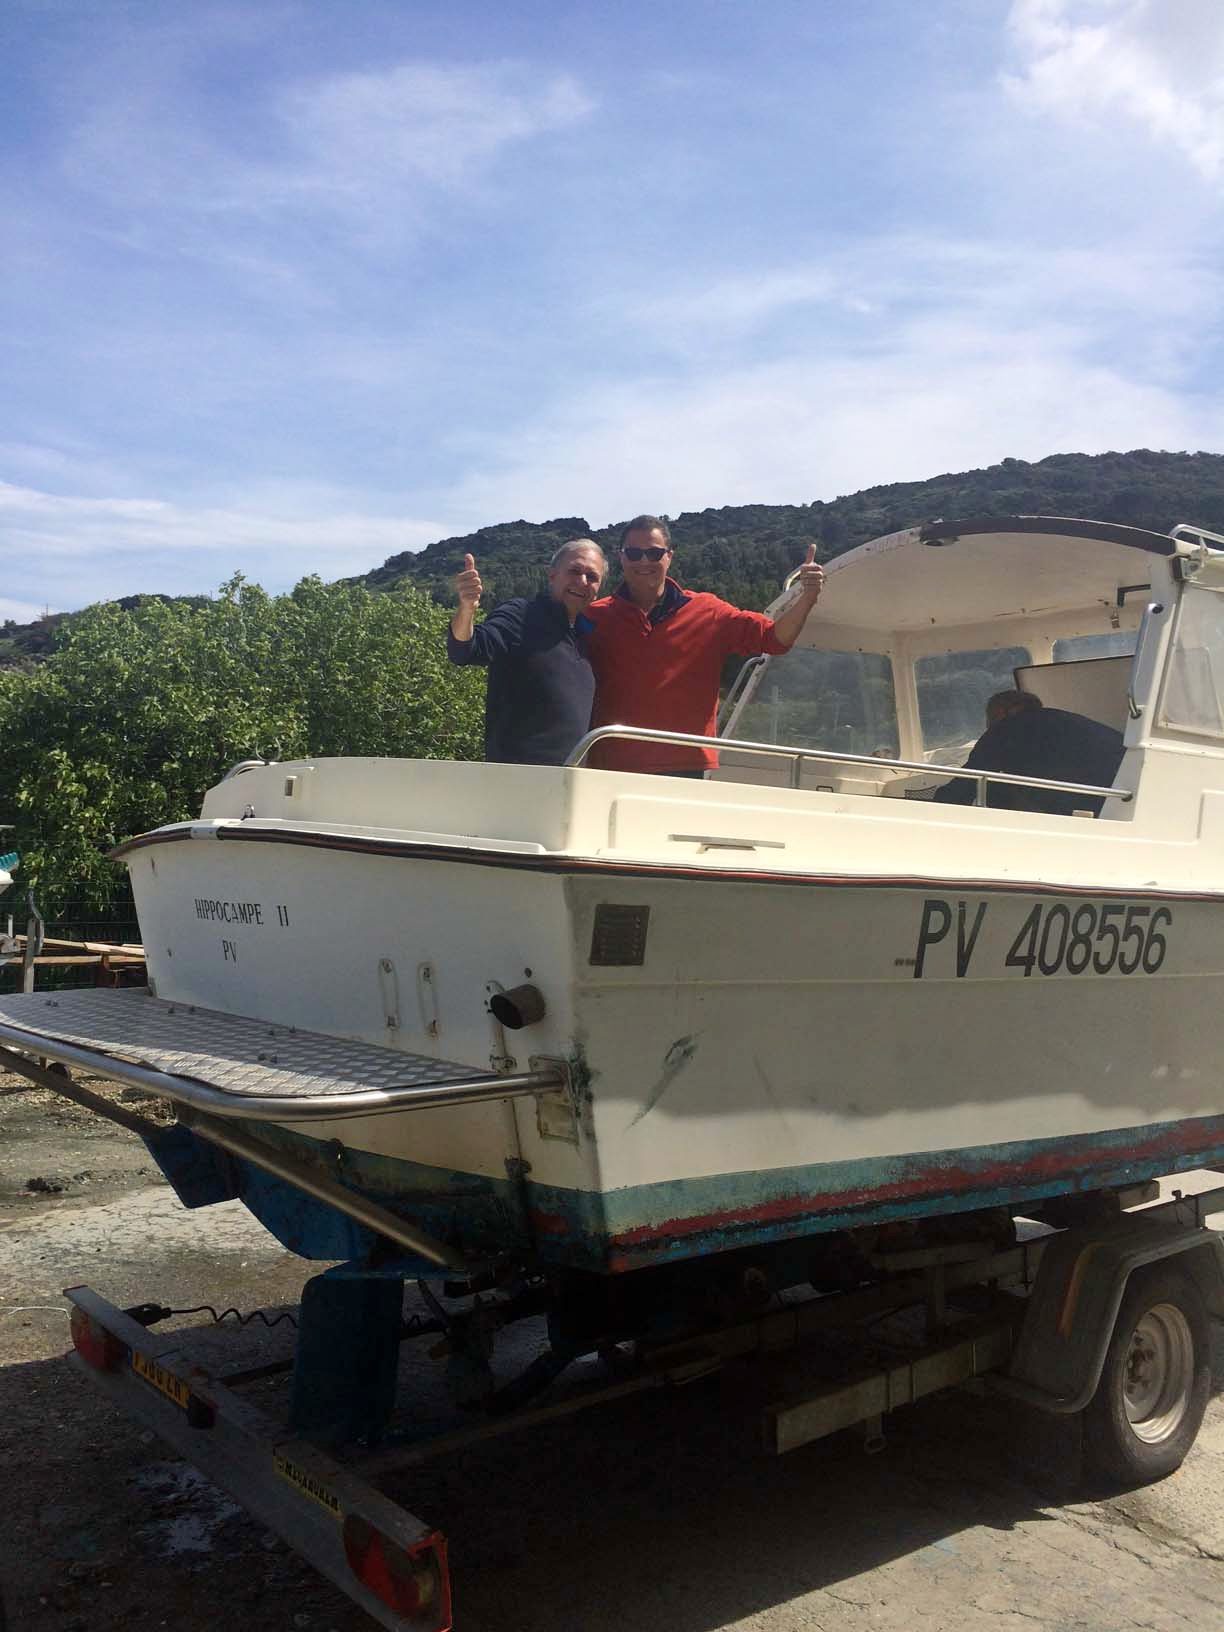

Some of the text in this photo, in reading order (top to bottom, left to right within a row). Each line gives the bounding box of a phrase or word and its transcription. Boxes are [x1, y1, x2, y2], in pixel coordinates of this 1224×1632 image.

[194, 898, 264, 925] HIPPOCAMPE
[222, 939, 237, 962] PV
[913, 899, 1173, 978] PV 408556
